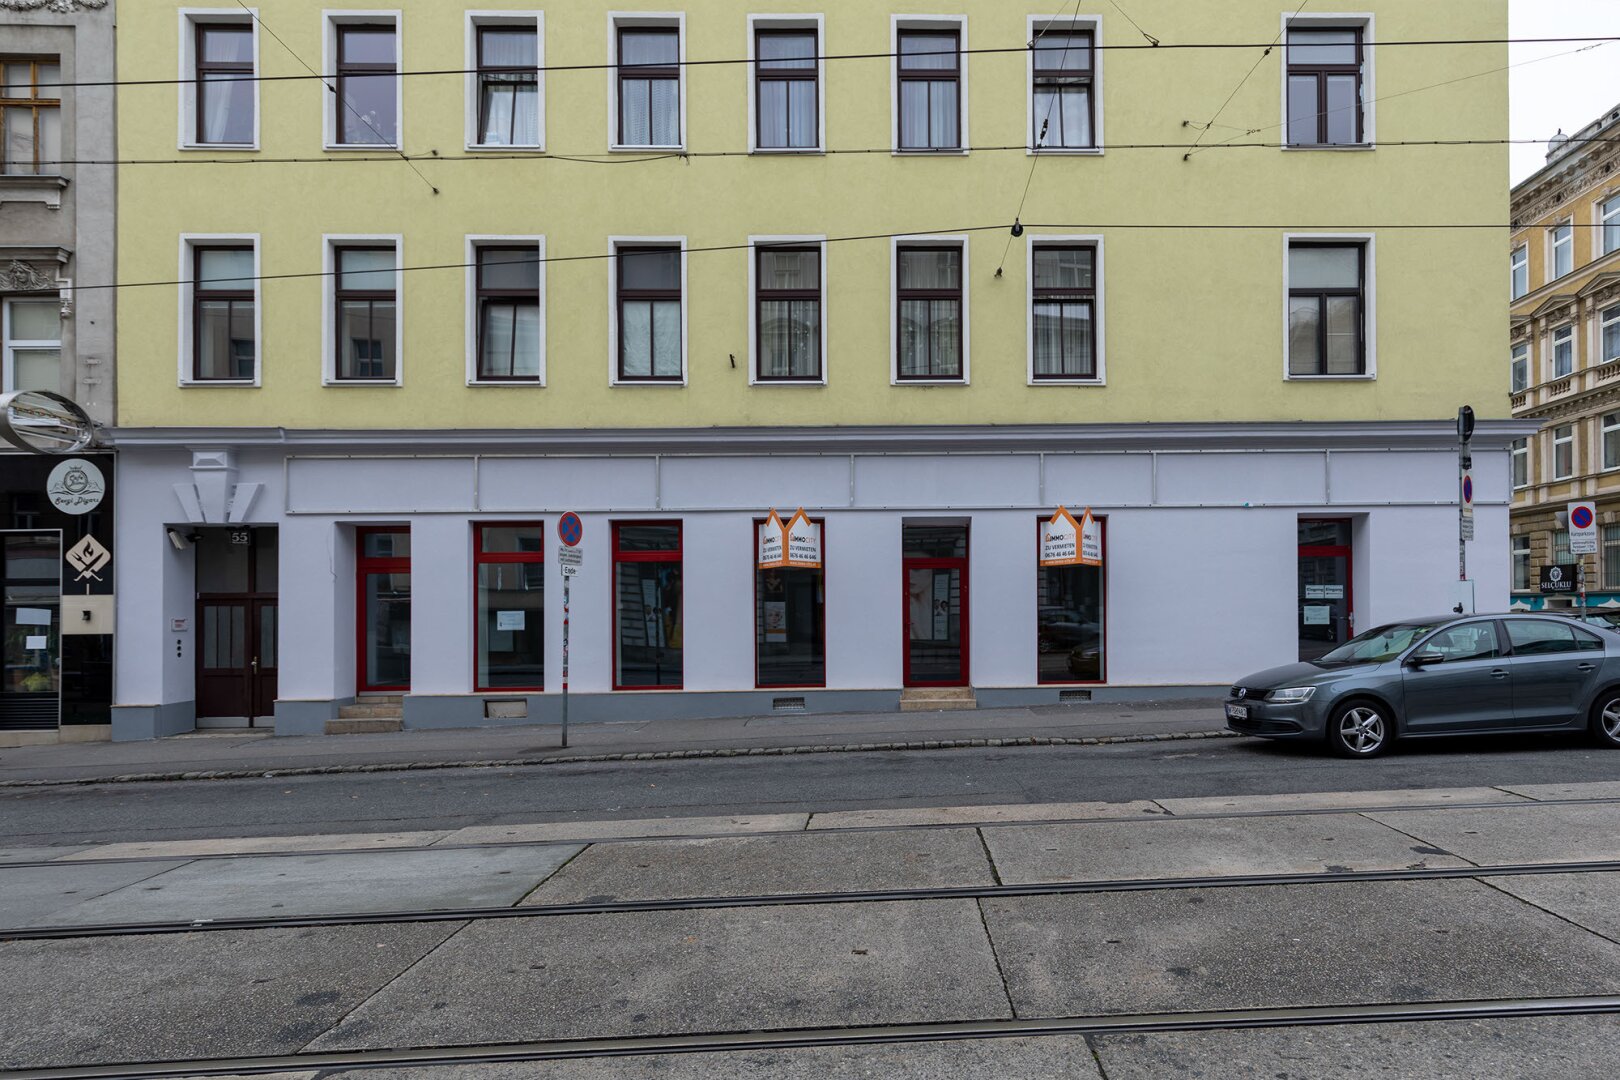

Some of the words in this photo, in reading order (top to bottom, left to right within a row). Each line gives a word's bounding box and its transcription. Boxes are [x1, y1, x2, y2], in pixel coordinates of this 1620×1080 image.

[231, 532, 249, 542] 55
[564, 566, 576, 575] Ende
[1541, 581, 1572, 589] SELÇUKLU
